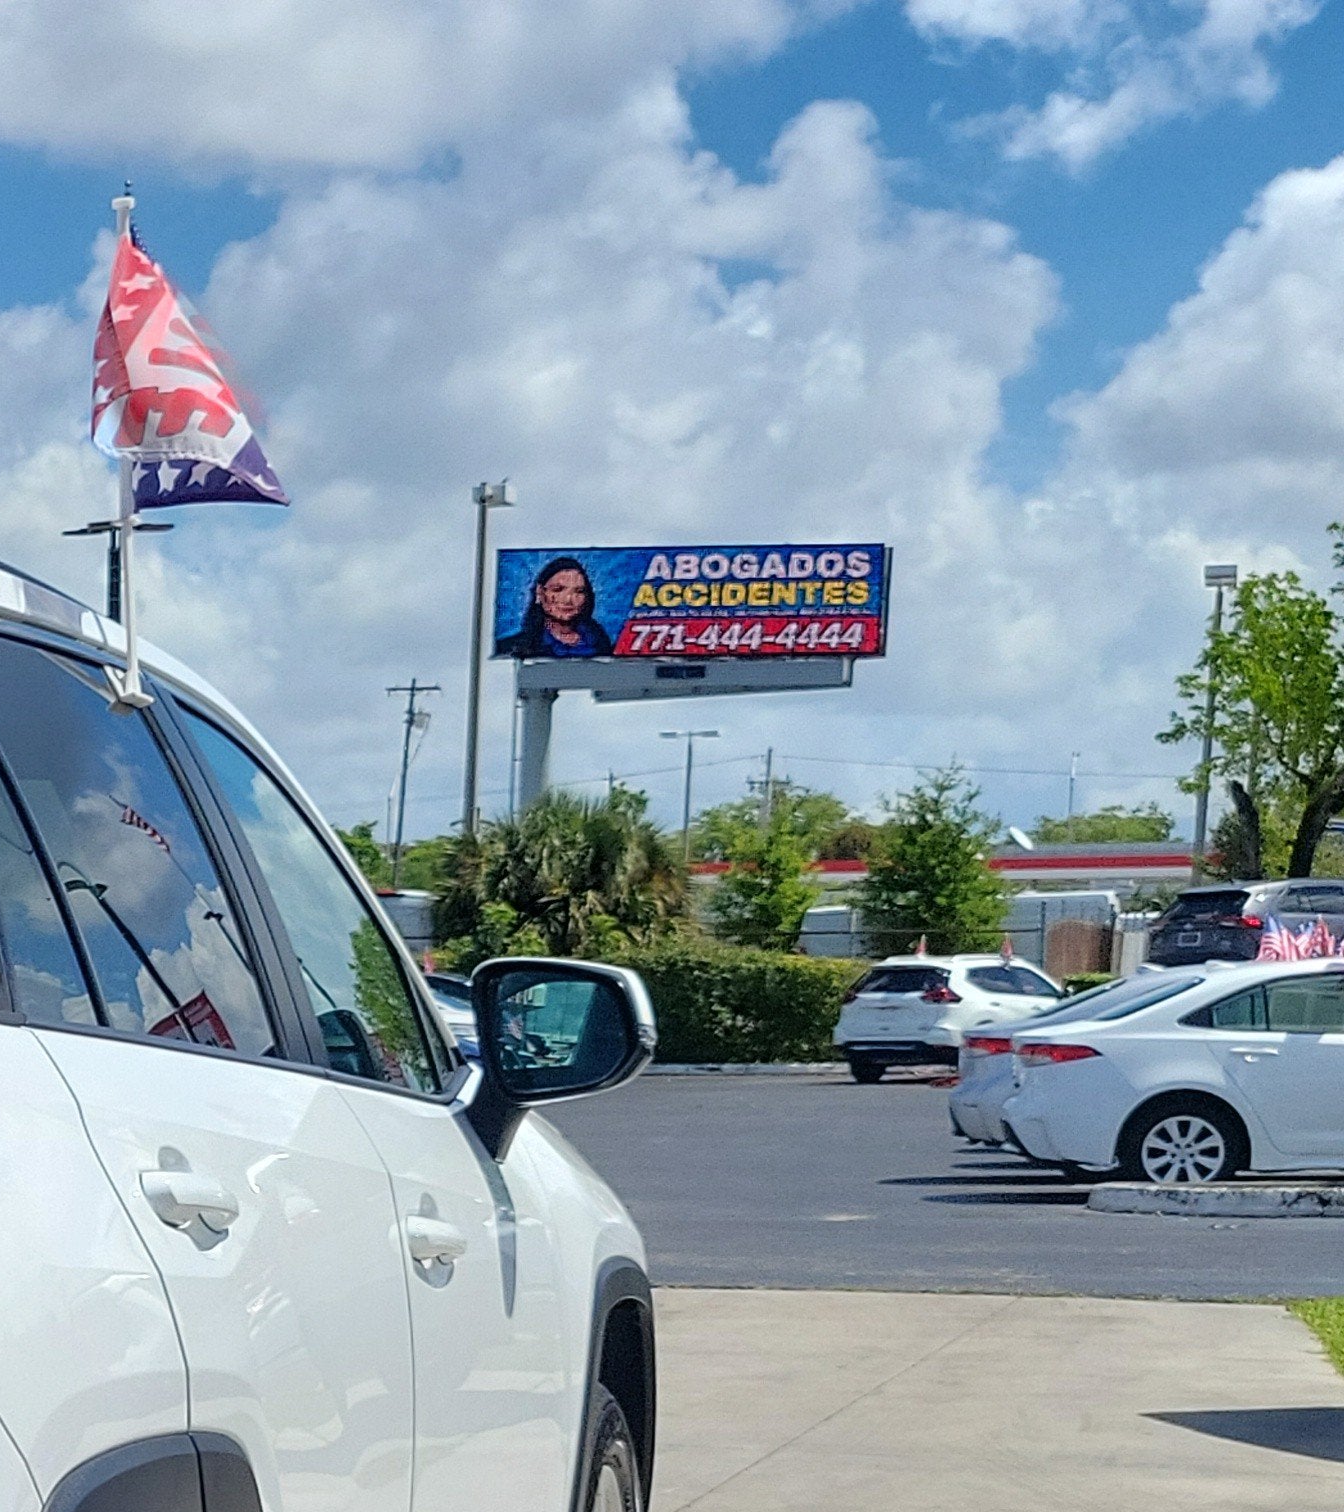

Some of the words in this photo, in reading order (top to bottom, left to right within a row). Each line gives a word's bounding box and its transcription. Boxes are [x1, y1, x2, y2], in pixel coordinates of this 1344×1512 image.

[645, 552, 871, 580] ABOGADOS
[633, 582, 870, 607] ACCIDENTES
[630, 622, 864, 651] 771-444-4444
